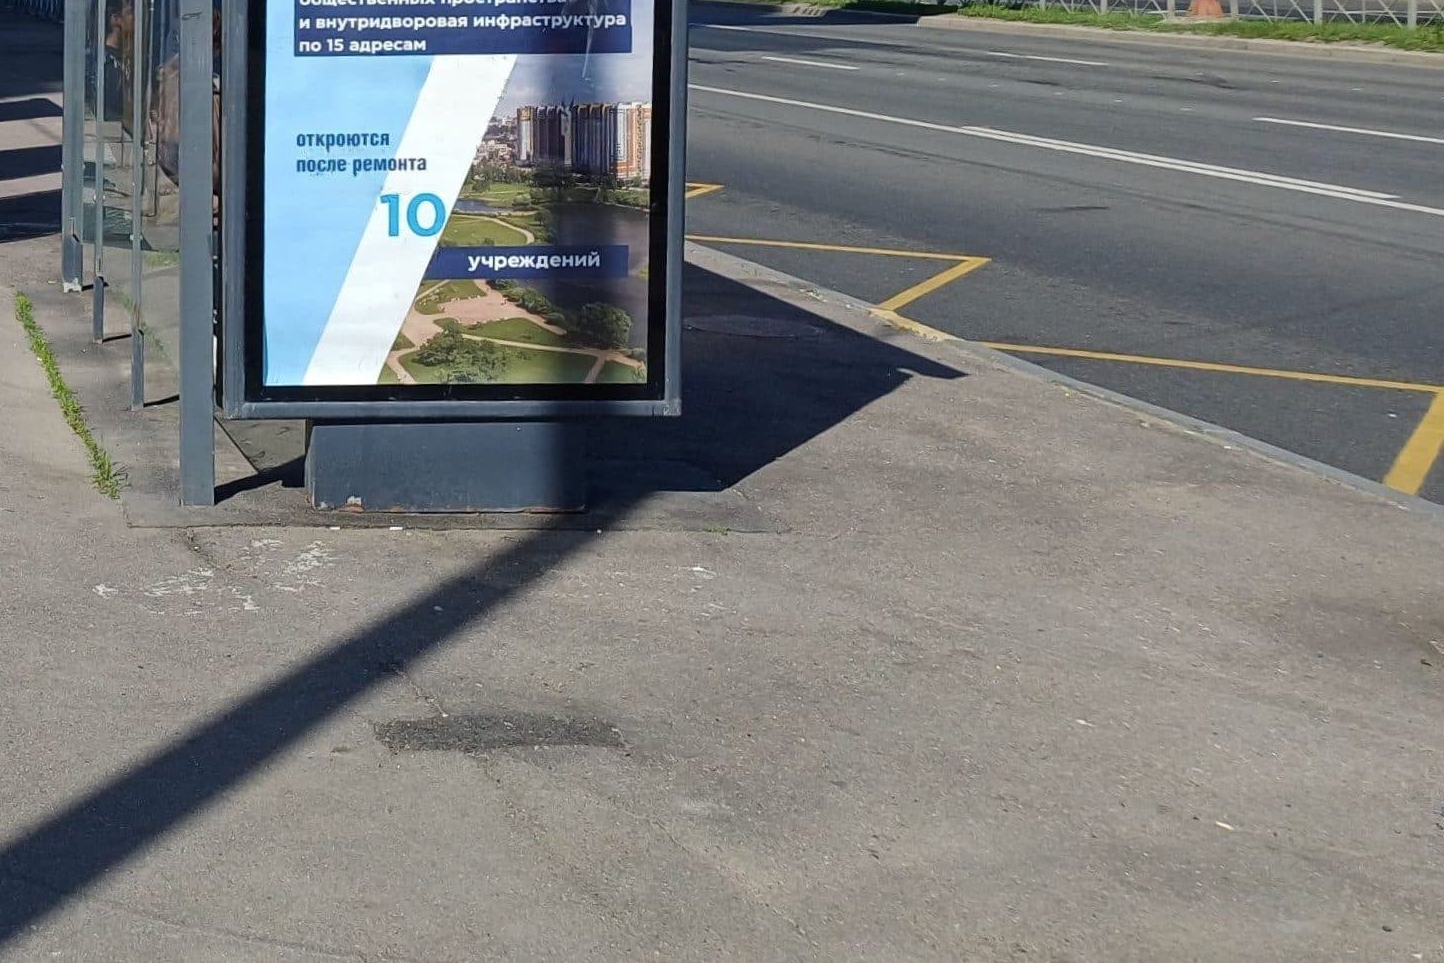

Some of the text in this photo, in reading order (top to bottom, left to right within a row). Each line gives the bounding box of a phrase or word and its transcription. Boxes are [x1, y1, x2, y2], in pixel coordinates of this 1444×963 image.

[299, 13, 627, 33] и внутридворовая инфраструктура
[299, 38, 426, 55] по 15 адресам
[296, 133, 390, 151] откроются
[296, 157, 427, 176] после ремонта
[380, 193, 446, 237] 10
[468, 252, 600, 272] учреждений
